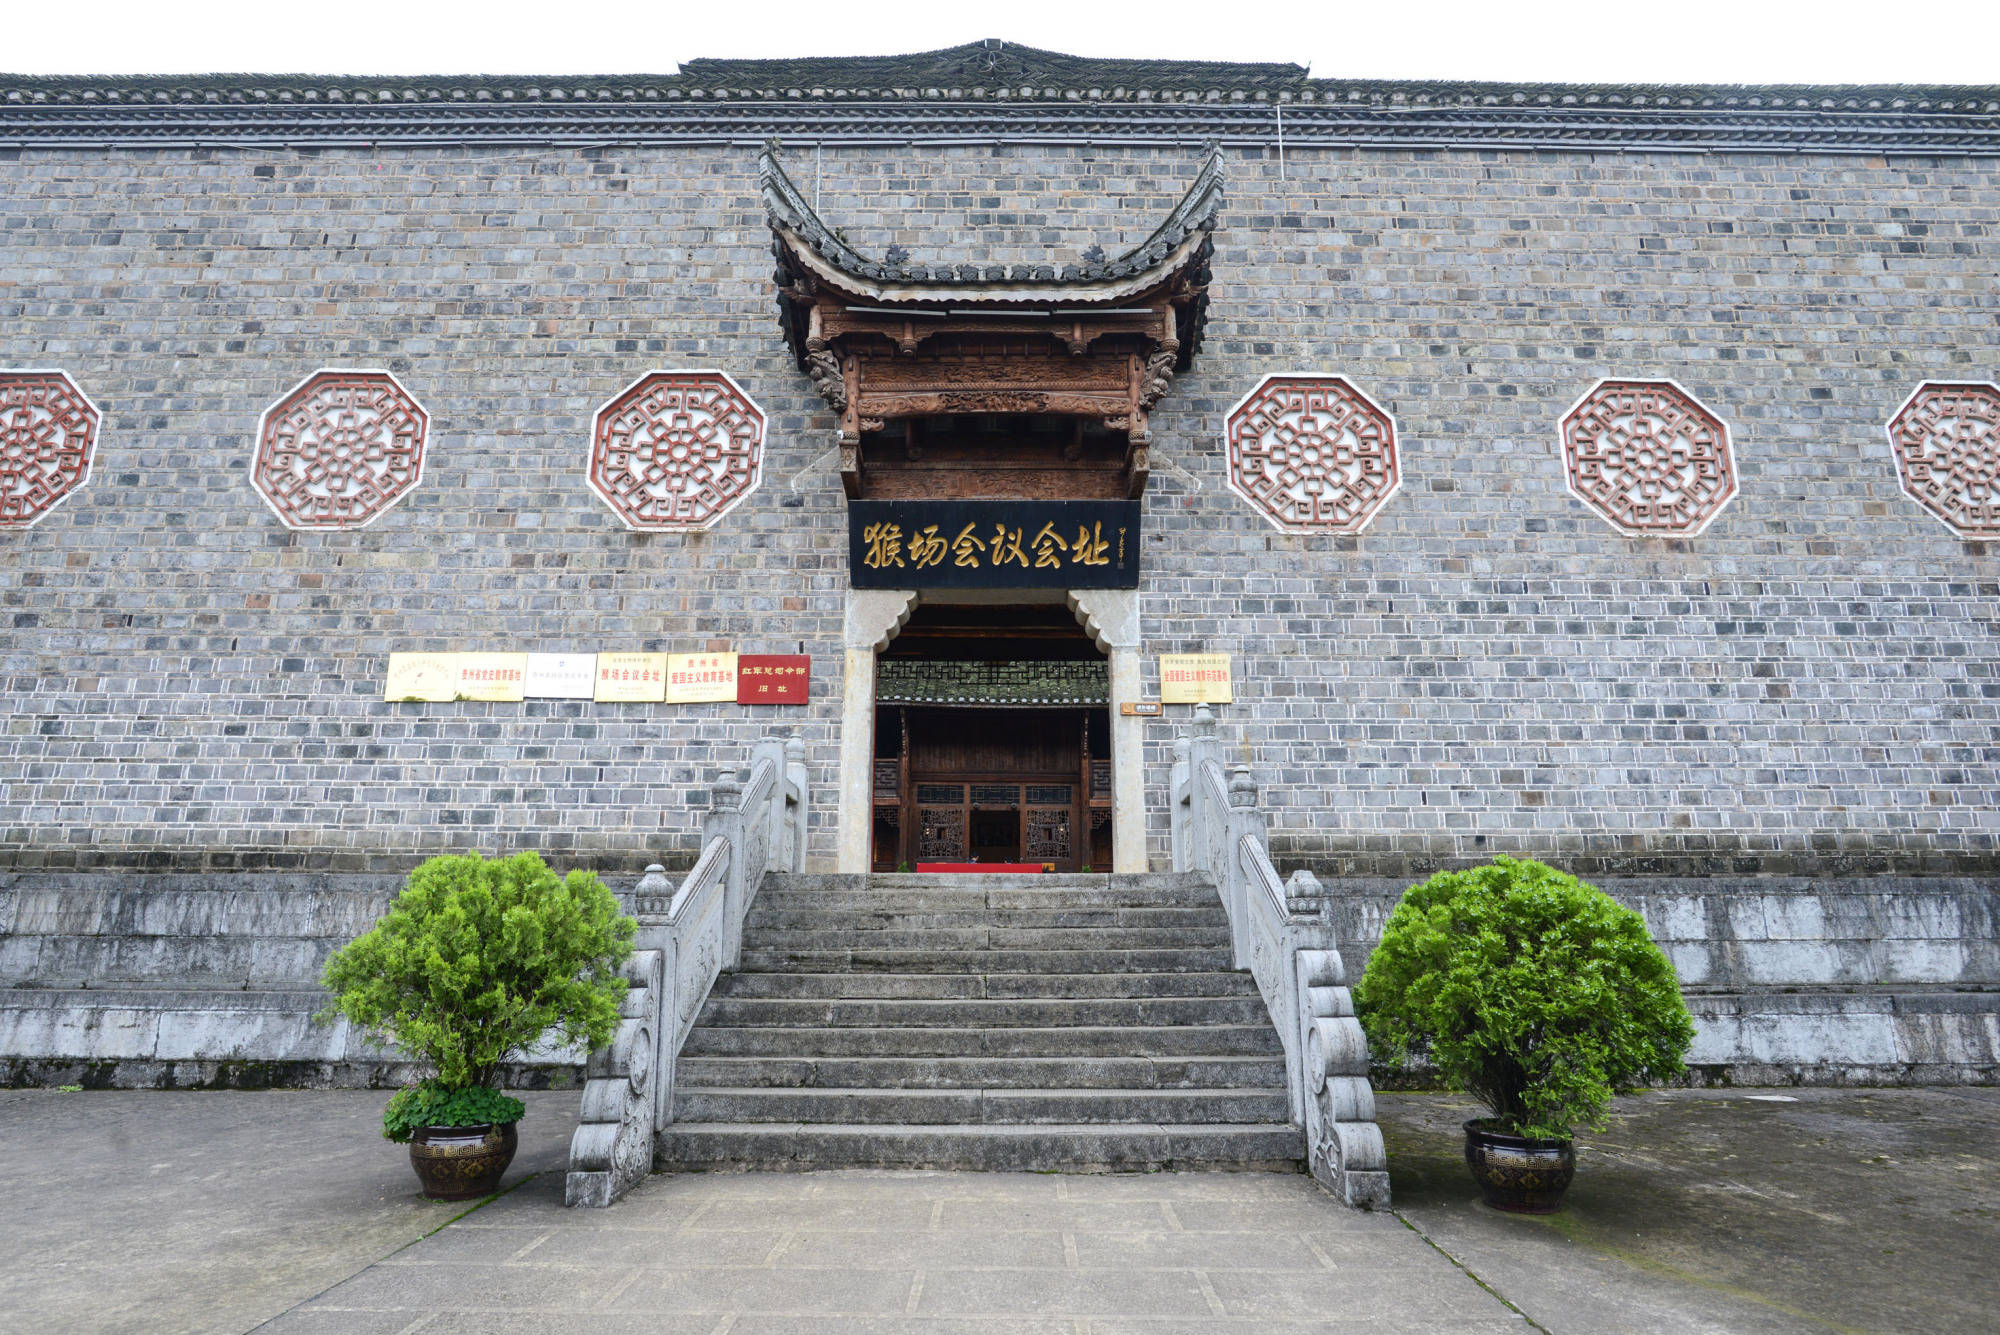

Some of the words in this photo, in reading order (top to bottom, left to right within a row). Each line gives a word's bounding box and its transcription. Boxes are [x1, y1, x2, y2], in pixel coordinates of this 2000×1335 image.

[864, 520, 1110, 570] 猴场会议会址
[601, 668, 661, 681] 猴场会议会址
[671, 671, 733, 684] 爱国主义教育基地
